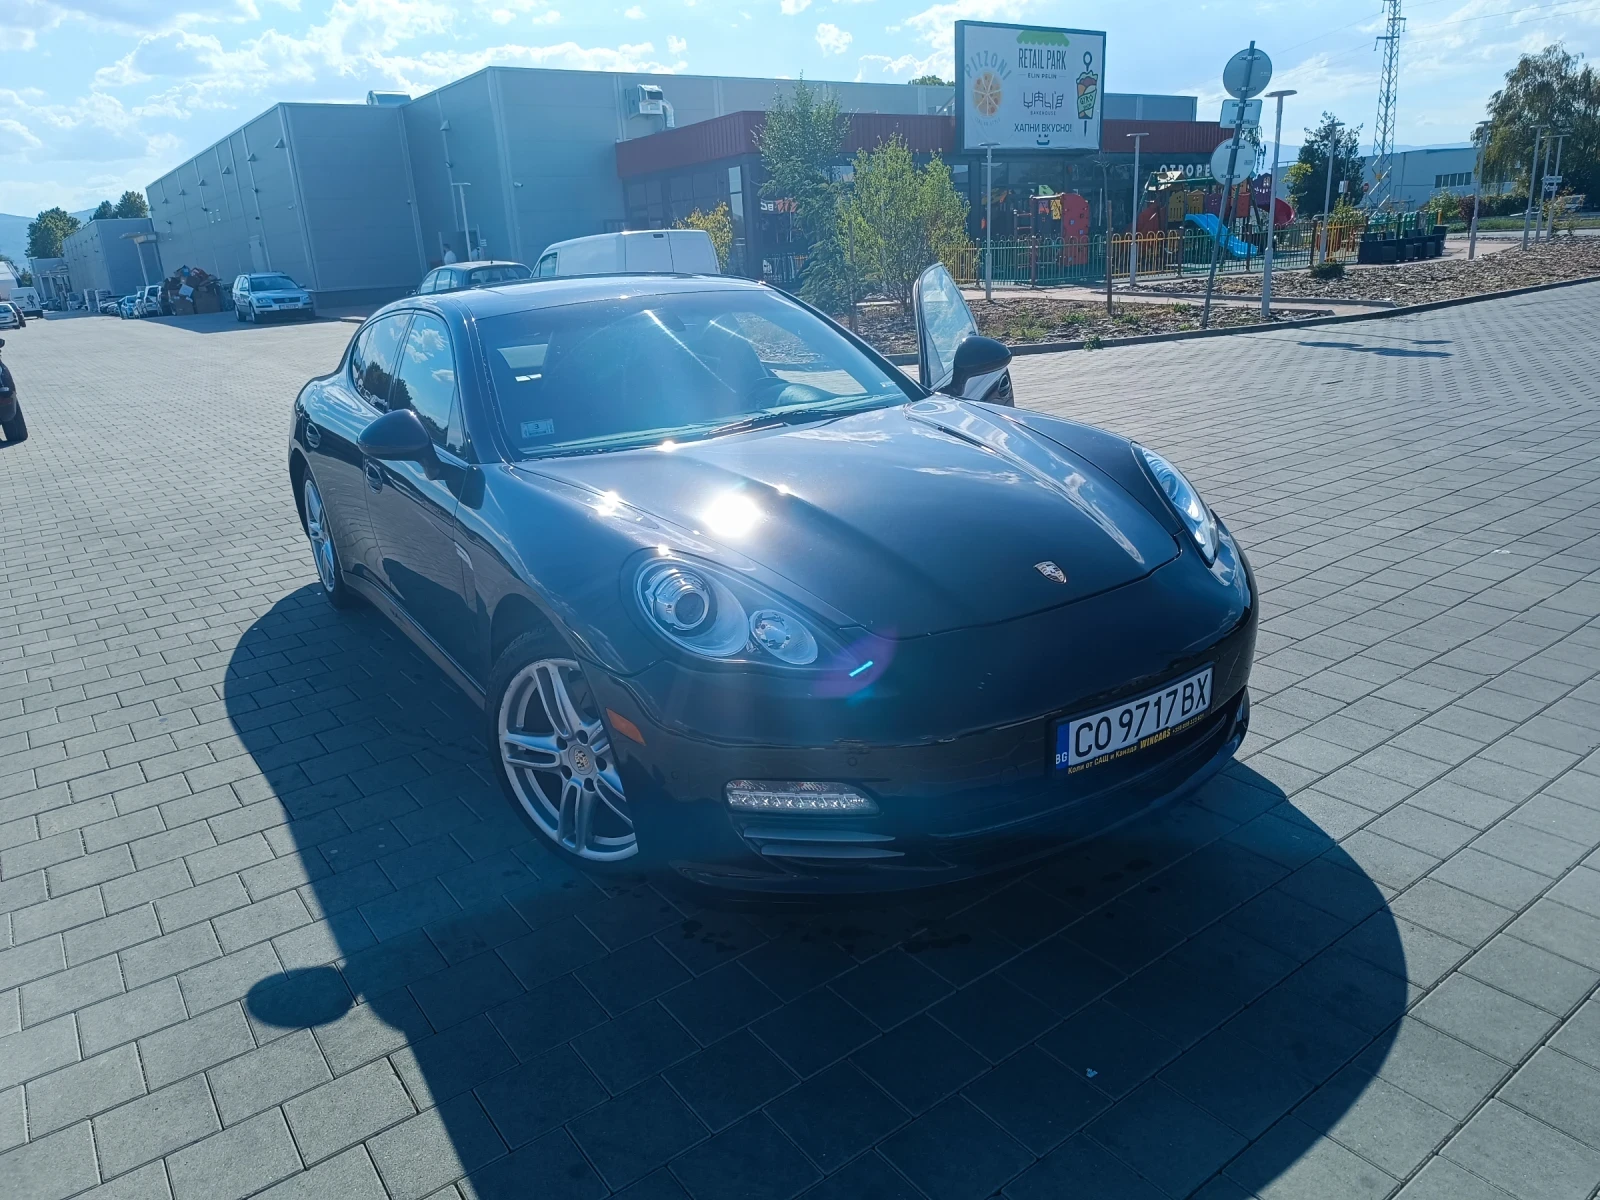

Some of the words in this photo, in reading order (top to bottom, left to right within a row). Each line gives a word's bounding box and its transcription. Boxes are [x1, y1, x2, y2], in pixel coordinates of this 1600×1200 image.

[965, 50, 1012, 80] PIZZONI
[1018, 47, 1045, 69] RETAIL
[1046, 50, 1067, 70] PARK
[1014, 123, 1040, 132] ХАПНИ
[1041, 123, 1072, 133] ВКУСНО!
[1118, 689, 1178, 743] 9717
[1140, 728, 1171, 750] WINCARS
[1055, 751, 1068, 765] BG
[1067, 763, 1085, 775] Коли
[1085, 760, 1094, 769] от
[1094, 754, 1109, 766] САЩ
